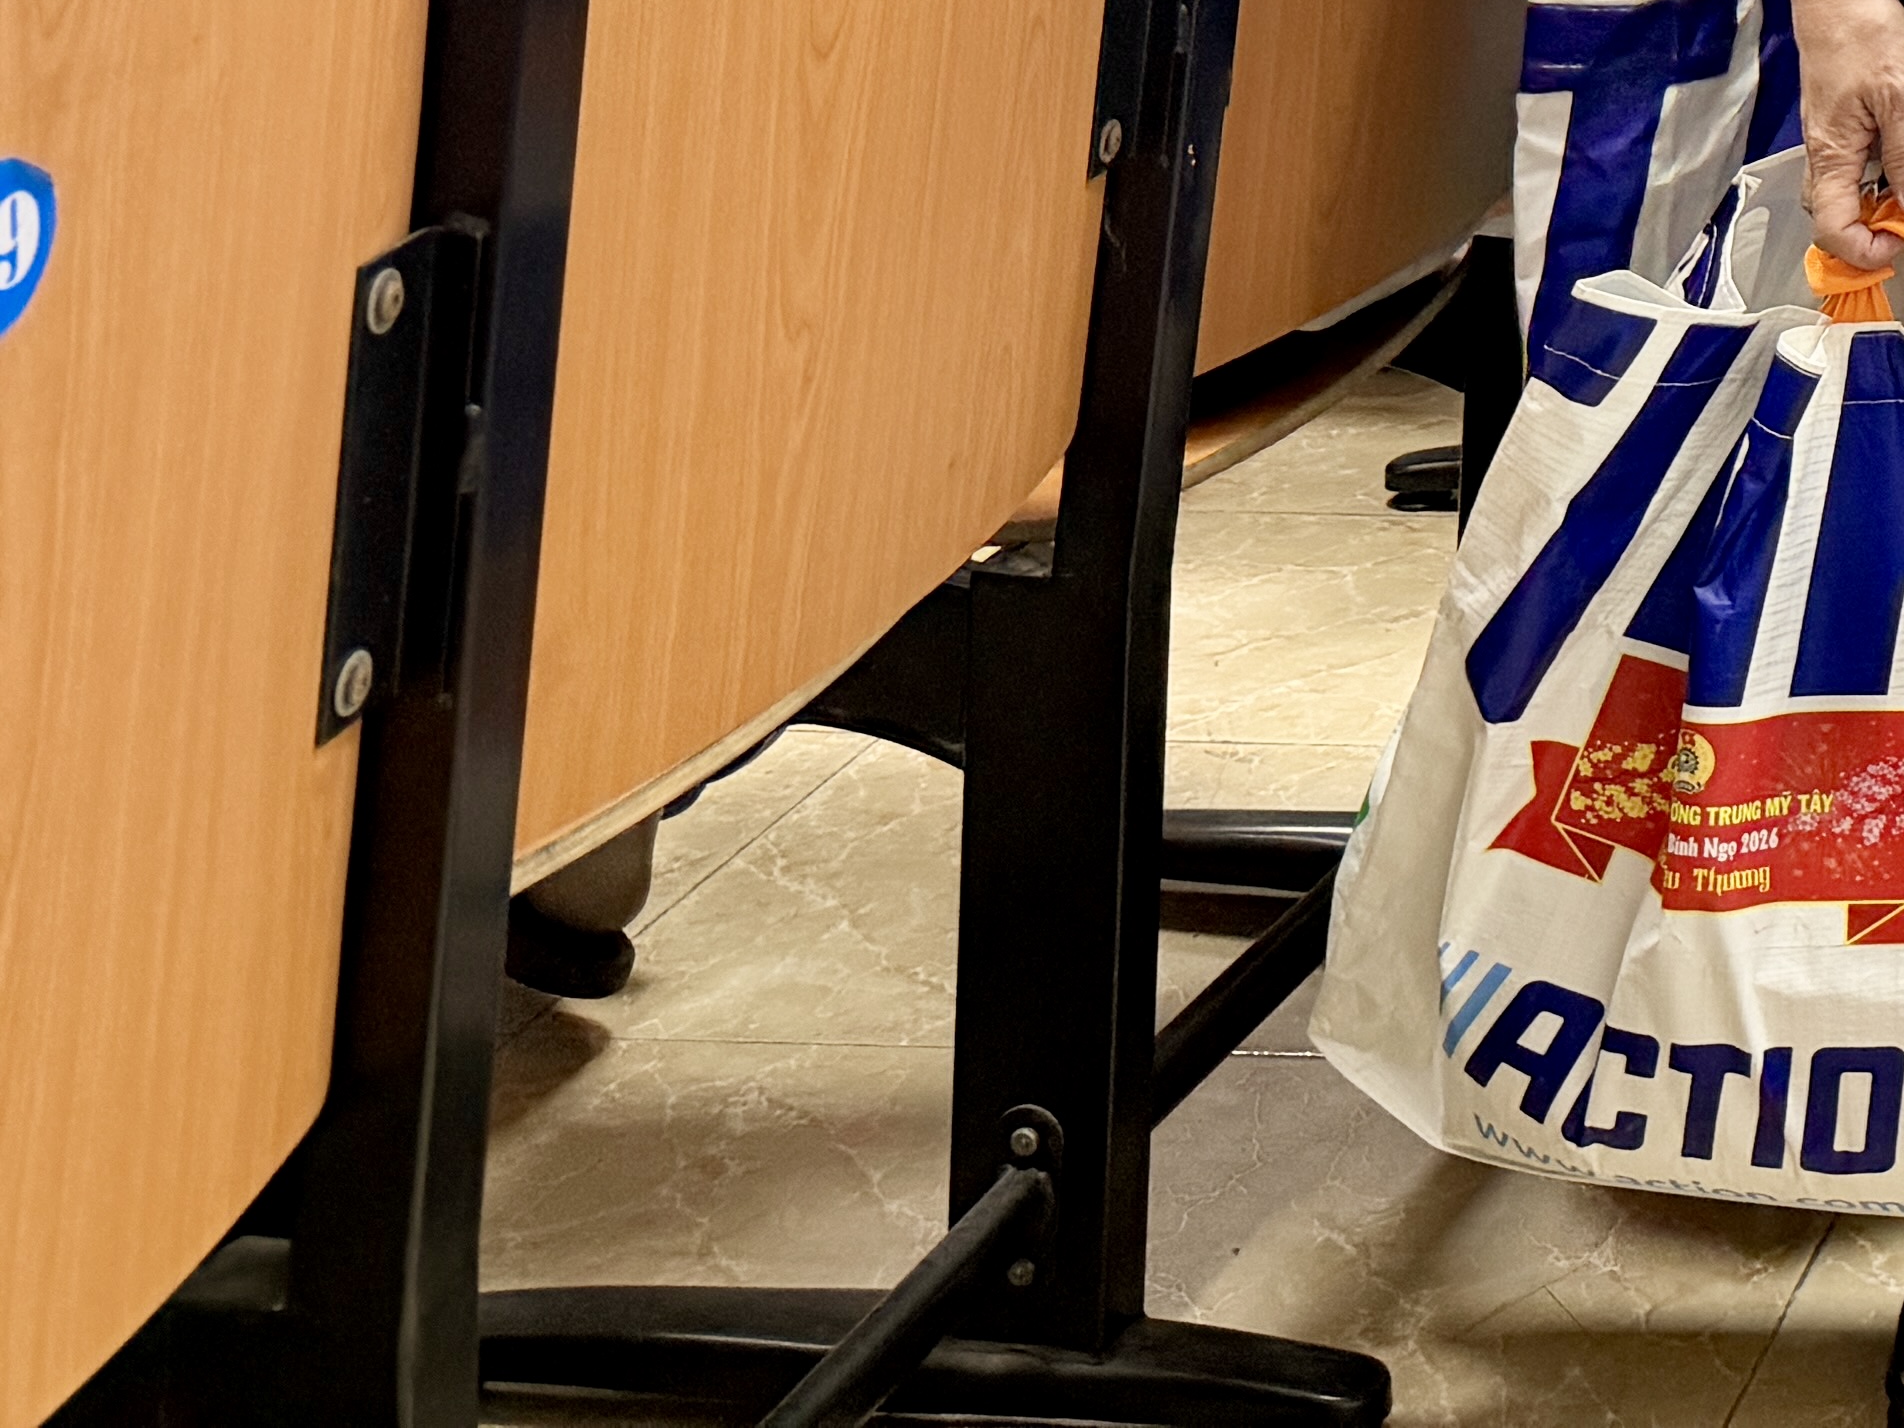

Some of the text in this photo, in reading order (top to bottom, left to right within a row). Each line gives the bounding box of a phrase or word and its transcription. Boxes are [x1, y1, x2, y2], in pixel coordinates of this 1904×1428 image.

[1706, 800, 1762, 827] TRUNG
[1765, 790, 1791, 819] MỸ
[1797, 789, 1835, 814] TÂY
[1703, 836, 1738, 862] Ngọ
[1740, 827, 1780, 854] 2026
